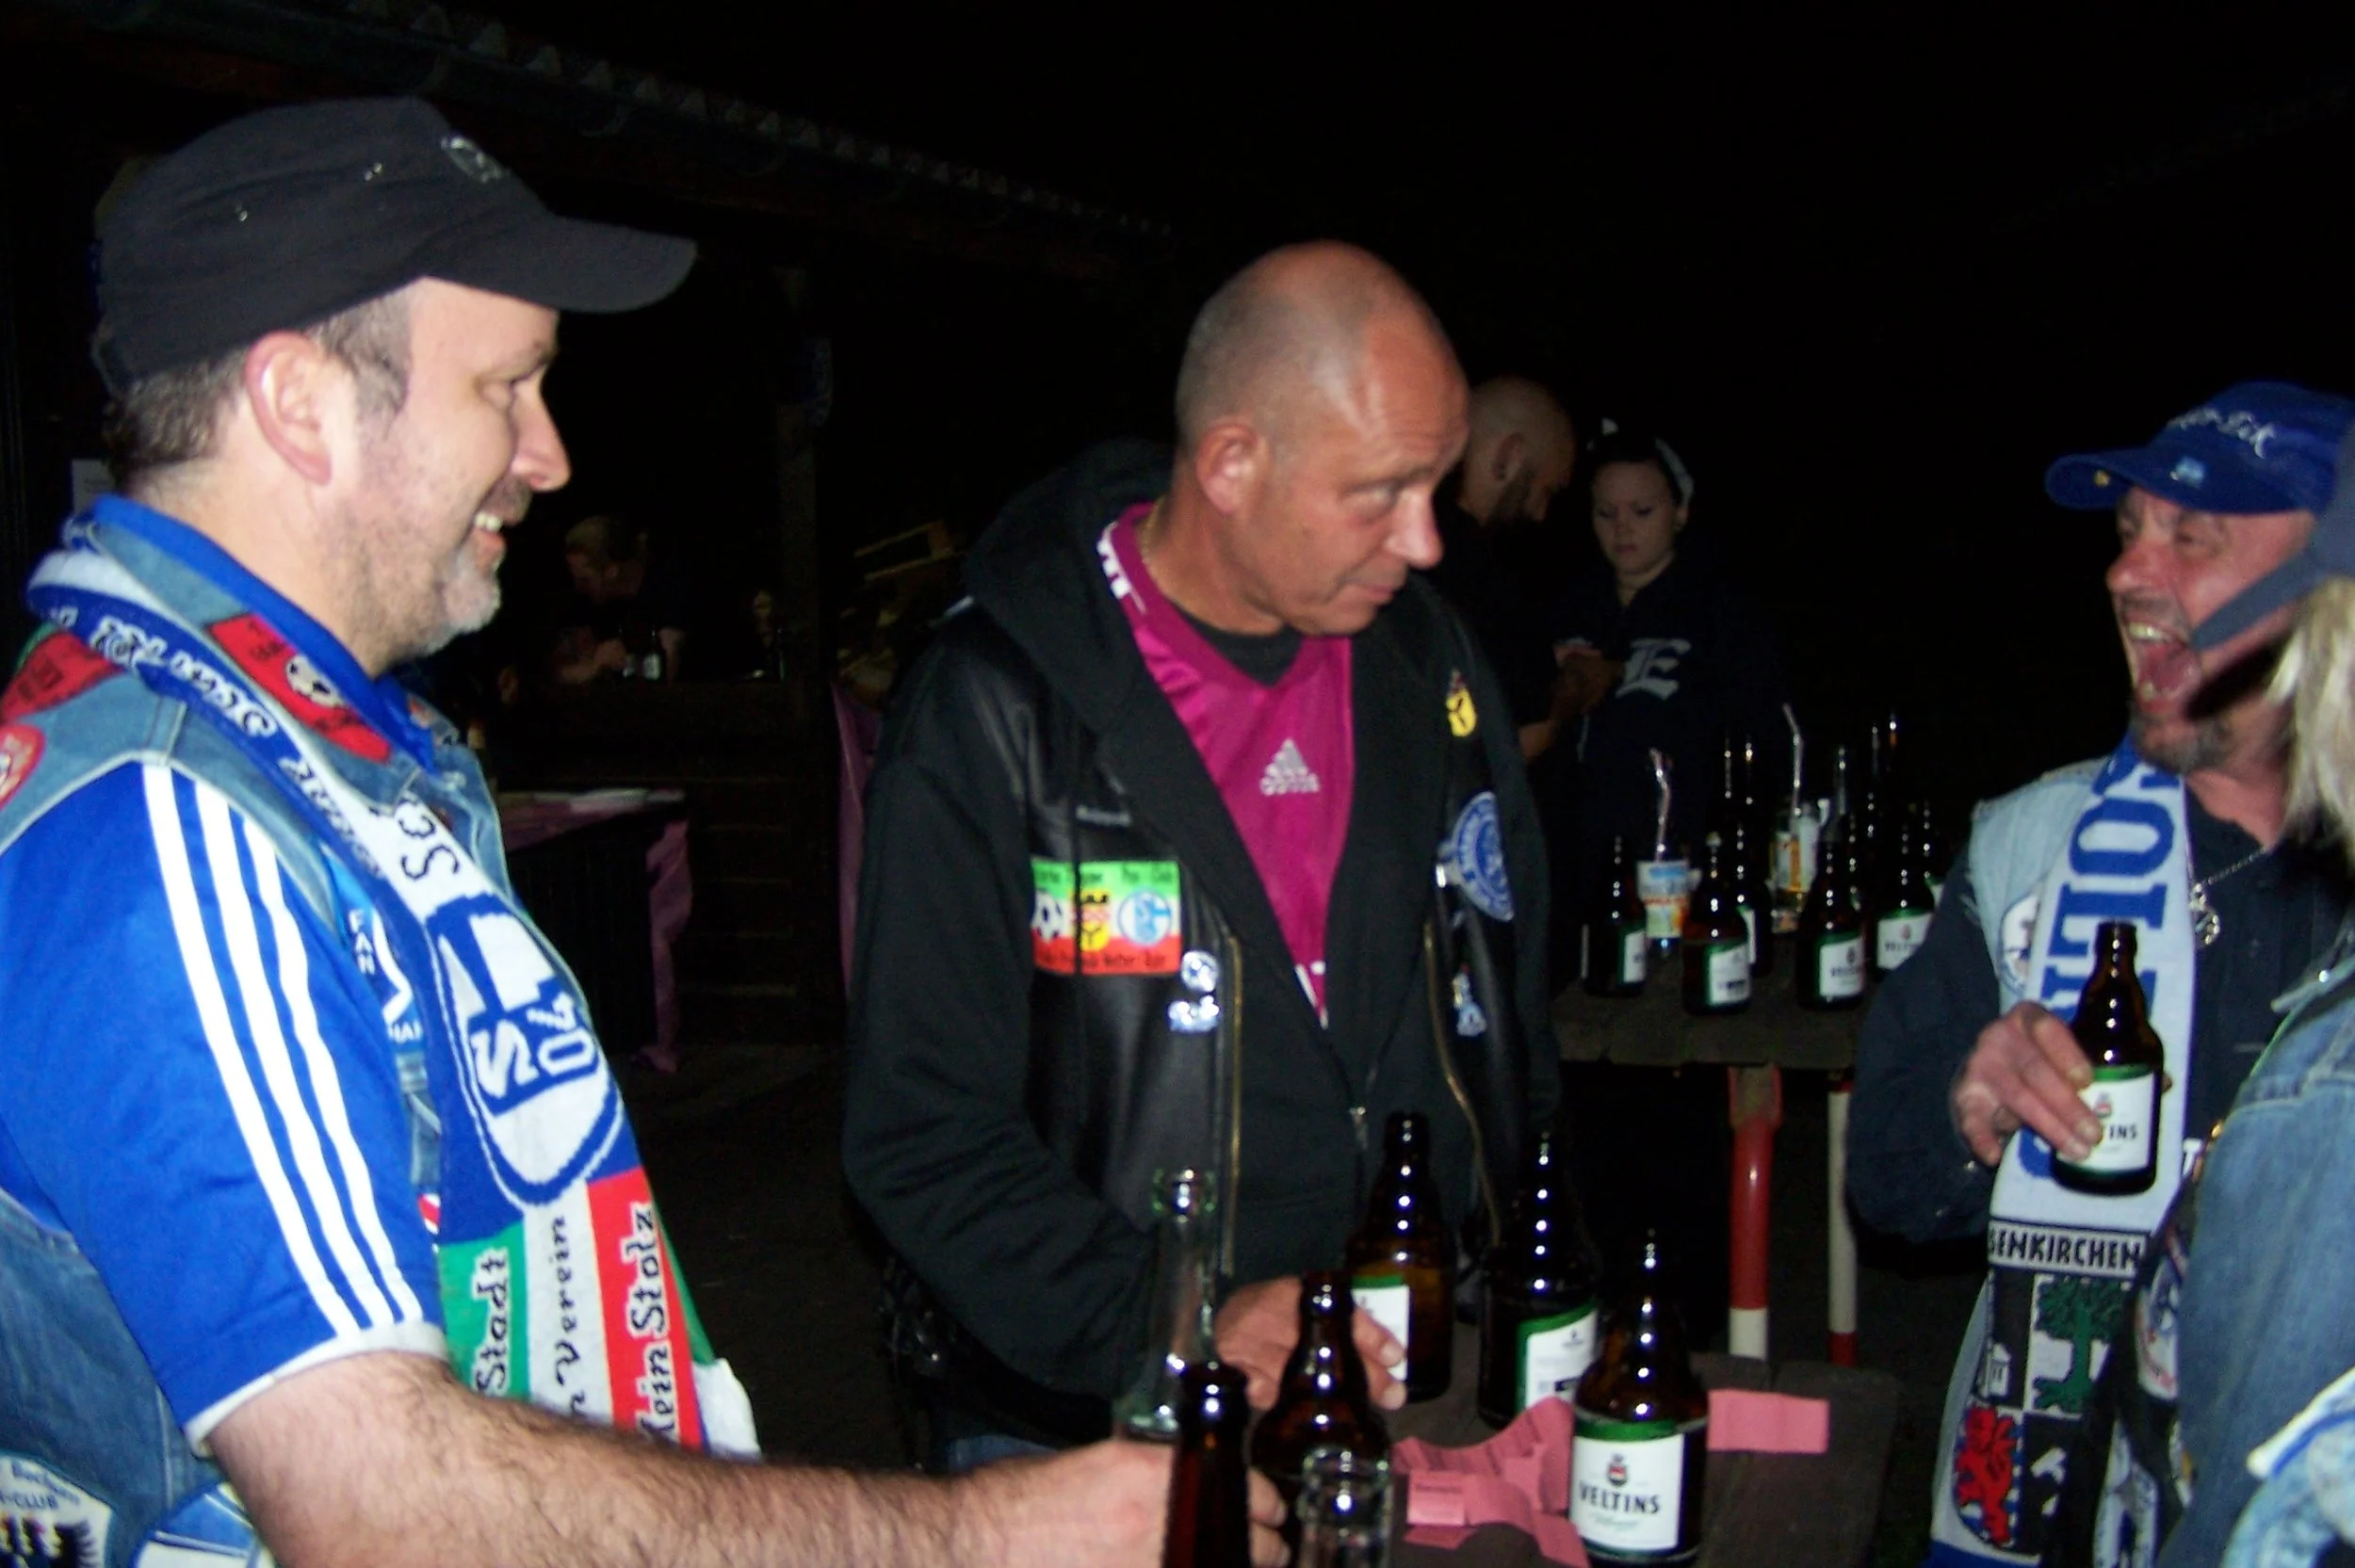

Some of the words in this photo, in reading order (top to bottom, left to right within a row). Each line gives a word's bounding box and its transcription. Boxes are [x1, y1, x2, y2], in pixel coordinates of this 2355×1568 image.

[475, 1256, 507, 1393] Stadt
[552, 1216, 581, 1388] Verein
[625, 1207, 666, 1334] Stolz
[1580, 1480, 1660, 1514] VELTINS
